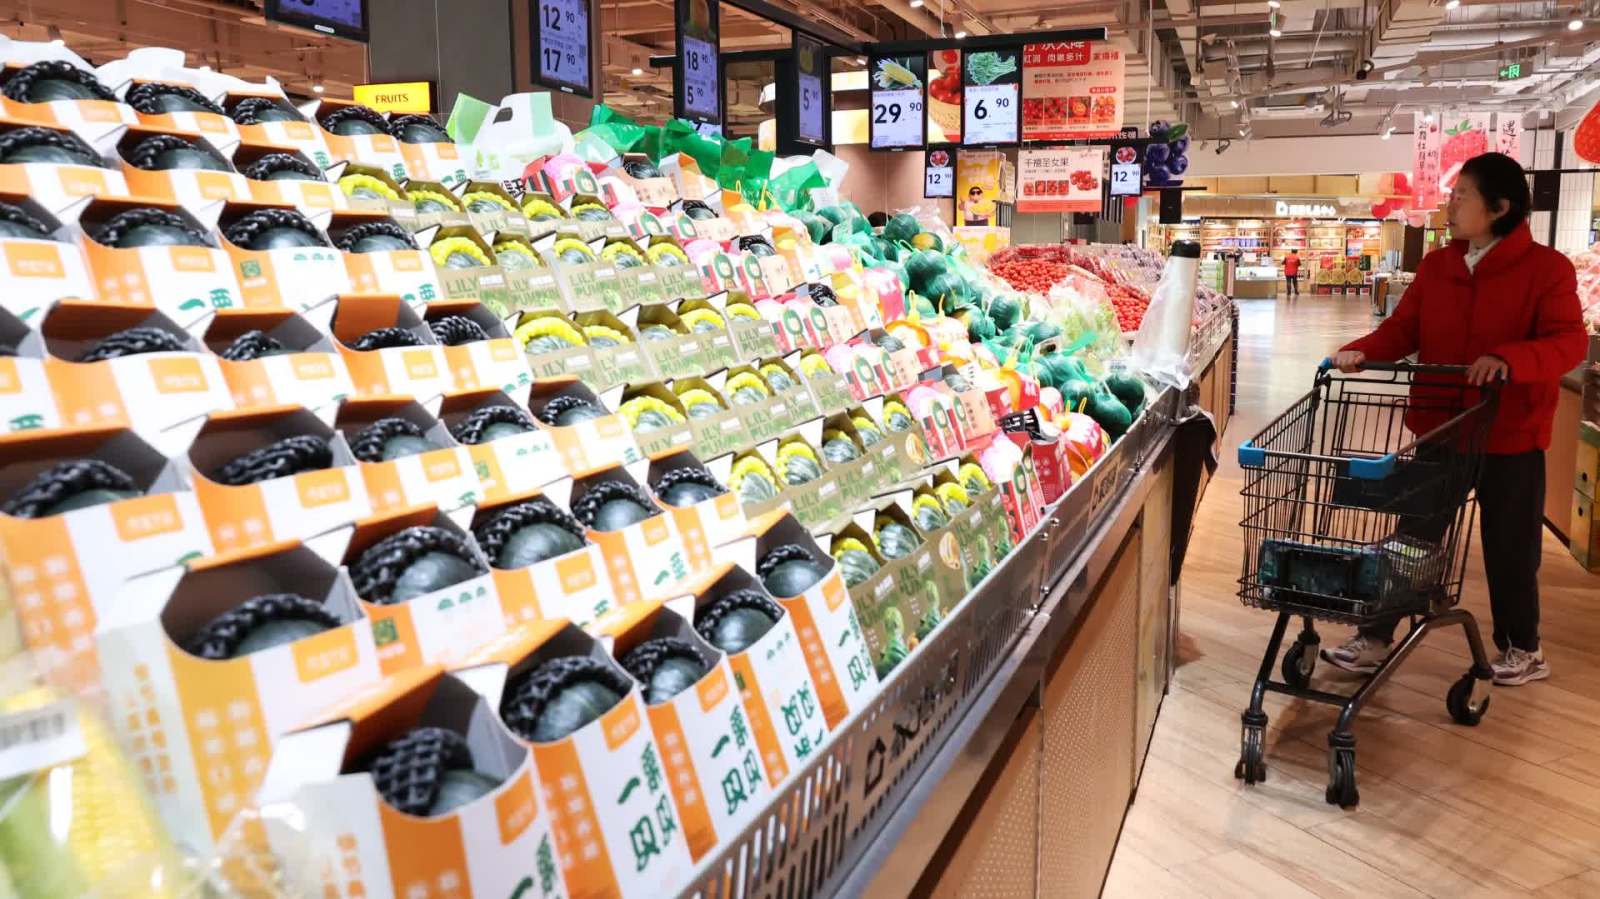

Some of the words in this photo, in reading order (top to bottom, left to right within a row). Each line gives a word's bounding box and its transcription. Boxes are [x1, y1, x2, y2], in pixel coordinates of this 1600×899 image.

[543, 5, 561, 31] 12
[566, 11, 575, 23] 90
[544, 48, 561, 72] 17
[567, 53, 576, 65] 90
[686, 50, 699, 71] 18
[375, 93, 409, 104] FRUITS
[687, 86, 694, 105] 5
[803, 89, 810, 110] 5
[996, 98, 1009, 108] 90
[909, 102, 922, 112] 90
[928, 174, 941, 185] 12
[1114, 171, 1128, 182] 12
[446, 275, 477, 294] LILY
